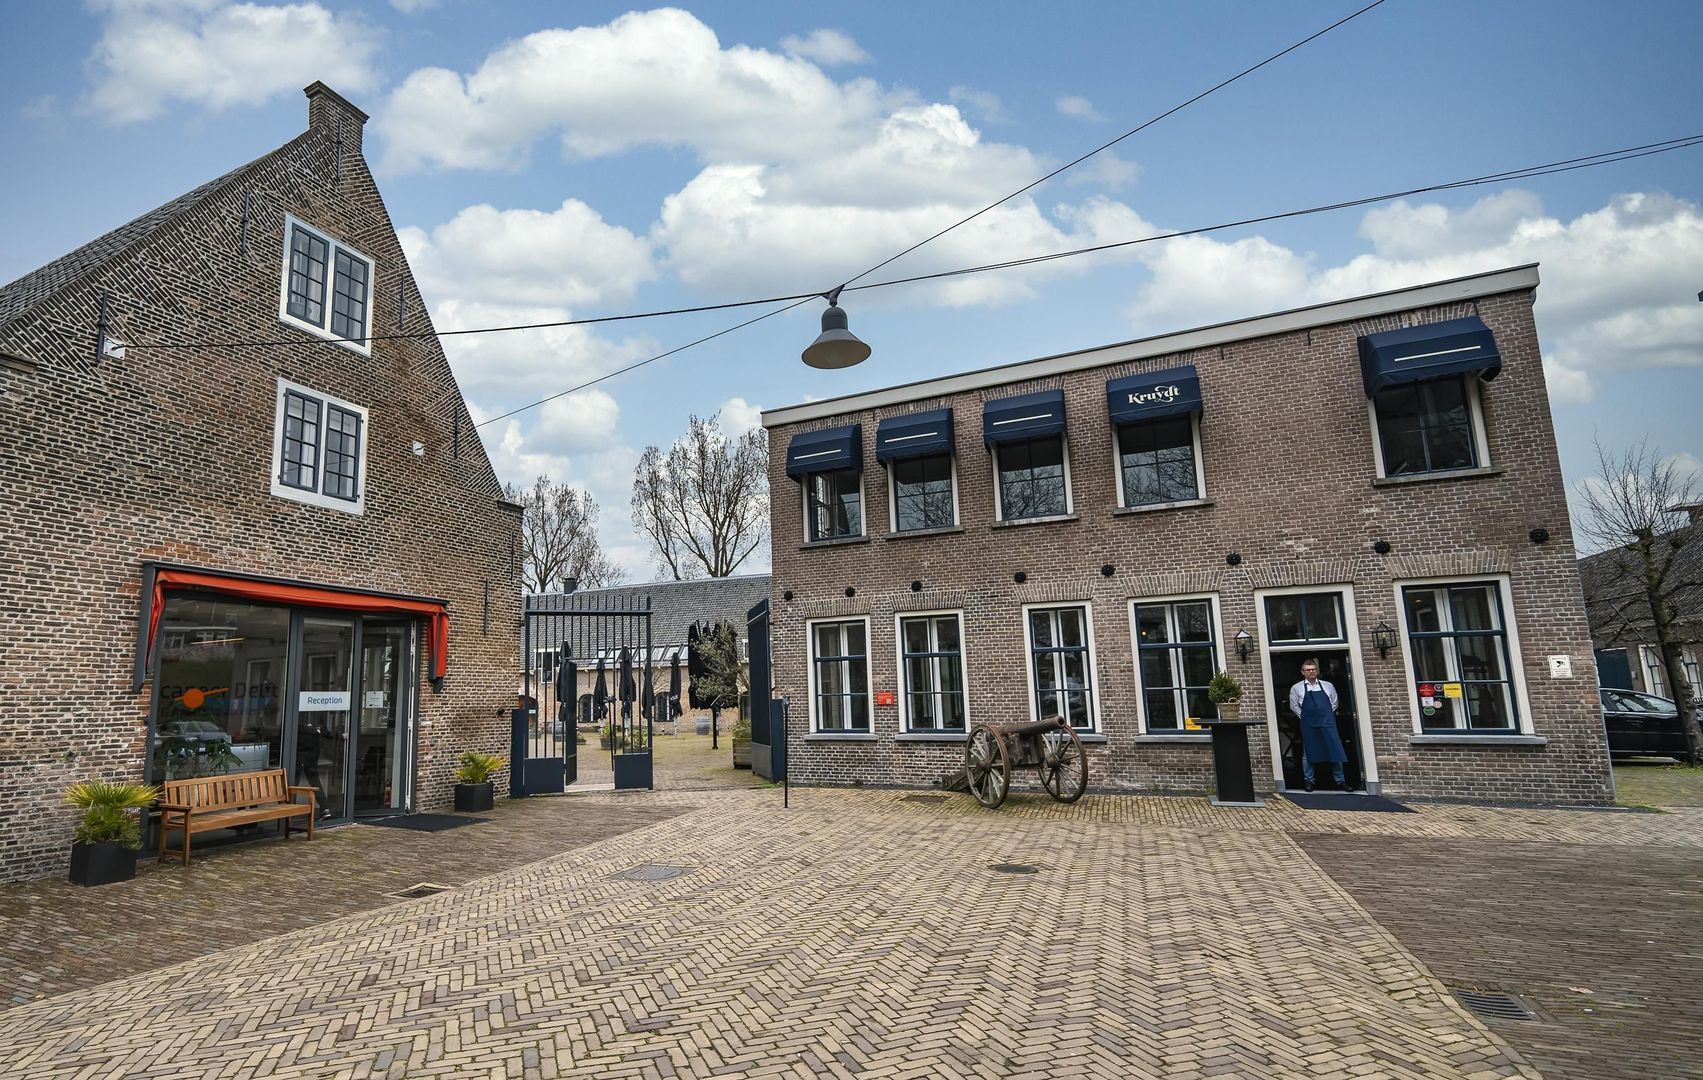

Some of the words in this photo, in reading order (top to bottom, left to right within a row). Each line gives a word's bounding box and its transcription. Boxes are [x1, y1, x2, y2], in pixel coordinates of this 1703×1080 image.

[1128, 385, 1180, 404] Kruydt
[235, 682, 279, 698] Delft
[307, 696, 343, 705] Reception
